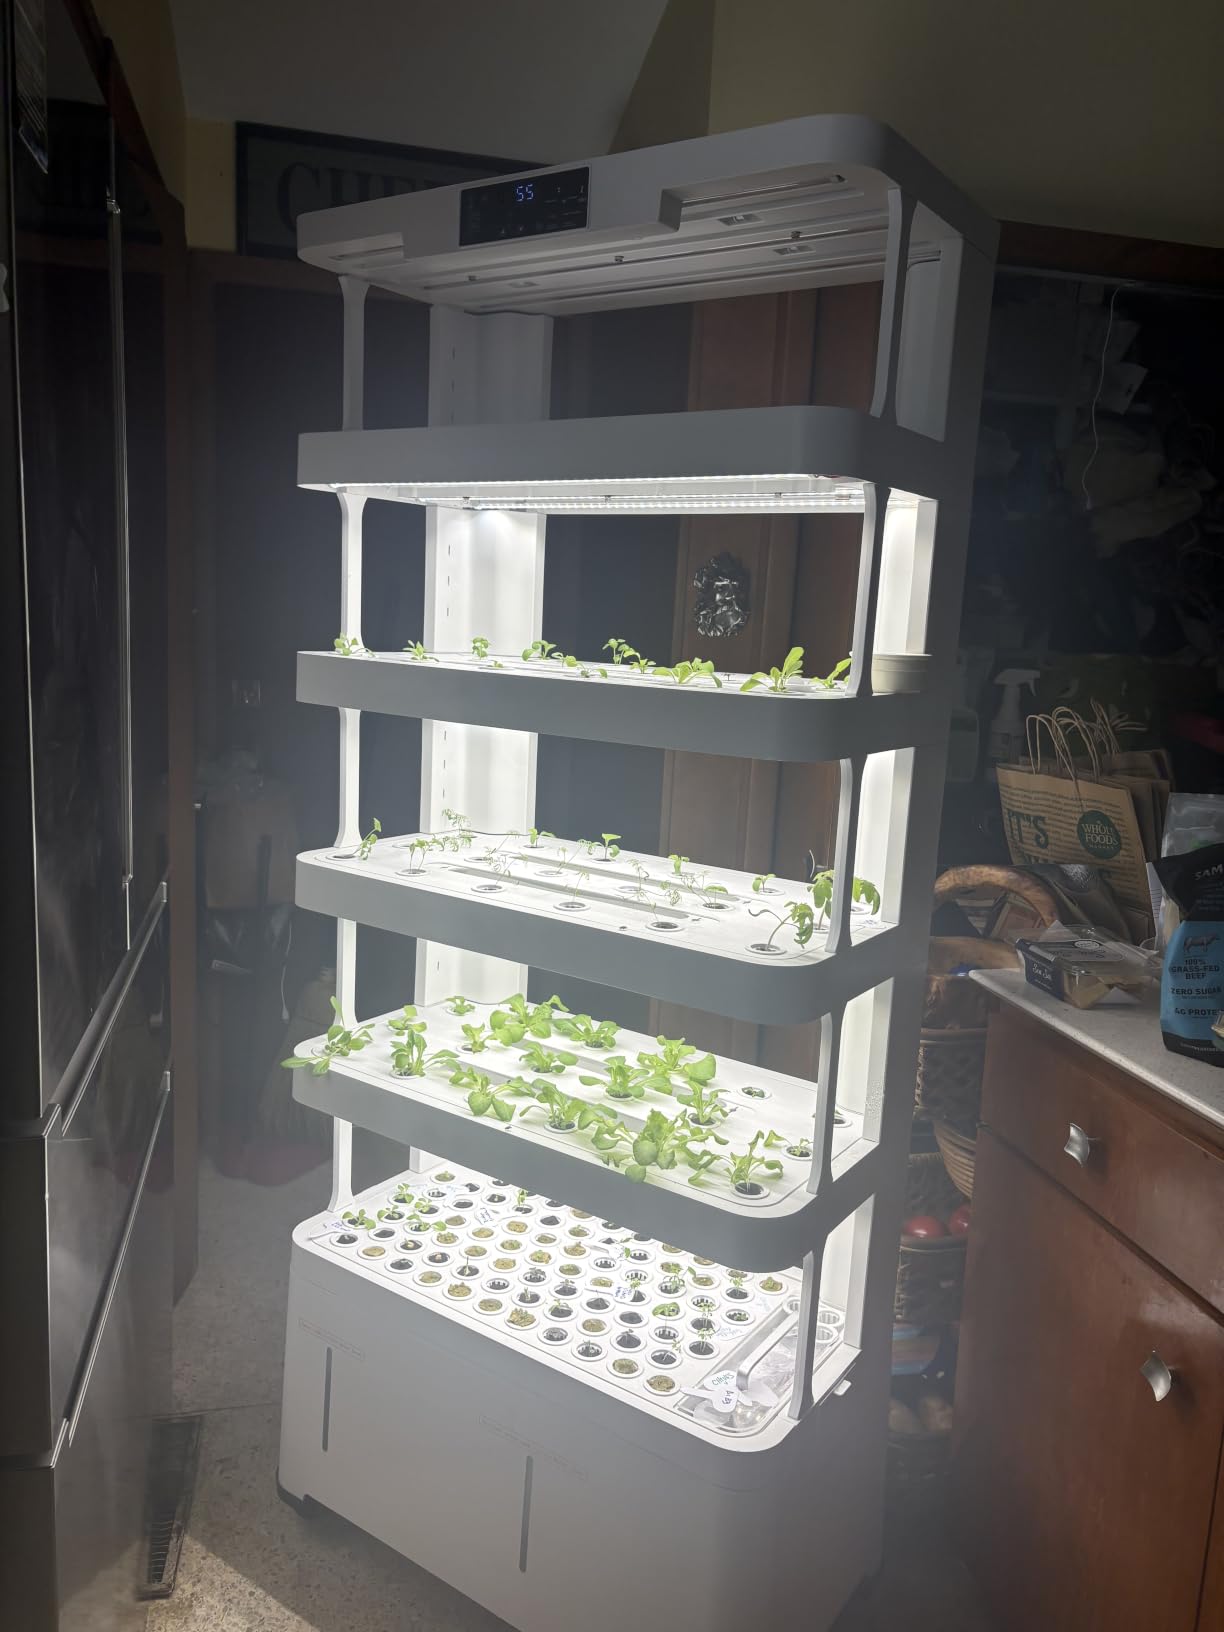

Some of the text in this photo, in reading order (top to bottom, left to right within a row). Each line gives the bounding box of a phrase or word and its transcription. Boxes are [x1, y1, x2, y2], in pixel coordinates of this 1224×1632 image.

[516, 183, 534, 202] 55
[1081, 823, 1114, 835] WHOLE
[1085, 833, 1119, 845] FOODS
[1185, 972, 1207, 980] BEEF
[1170, 986, 1193, 995] ZERO
